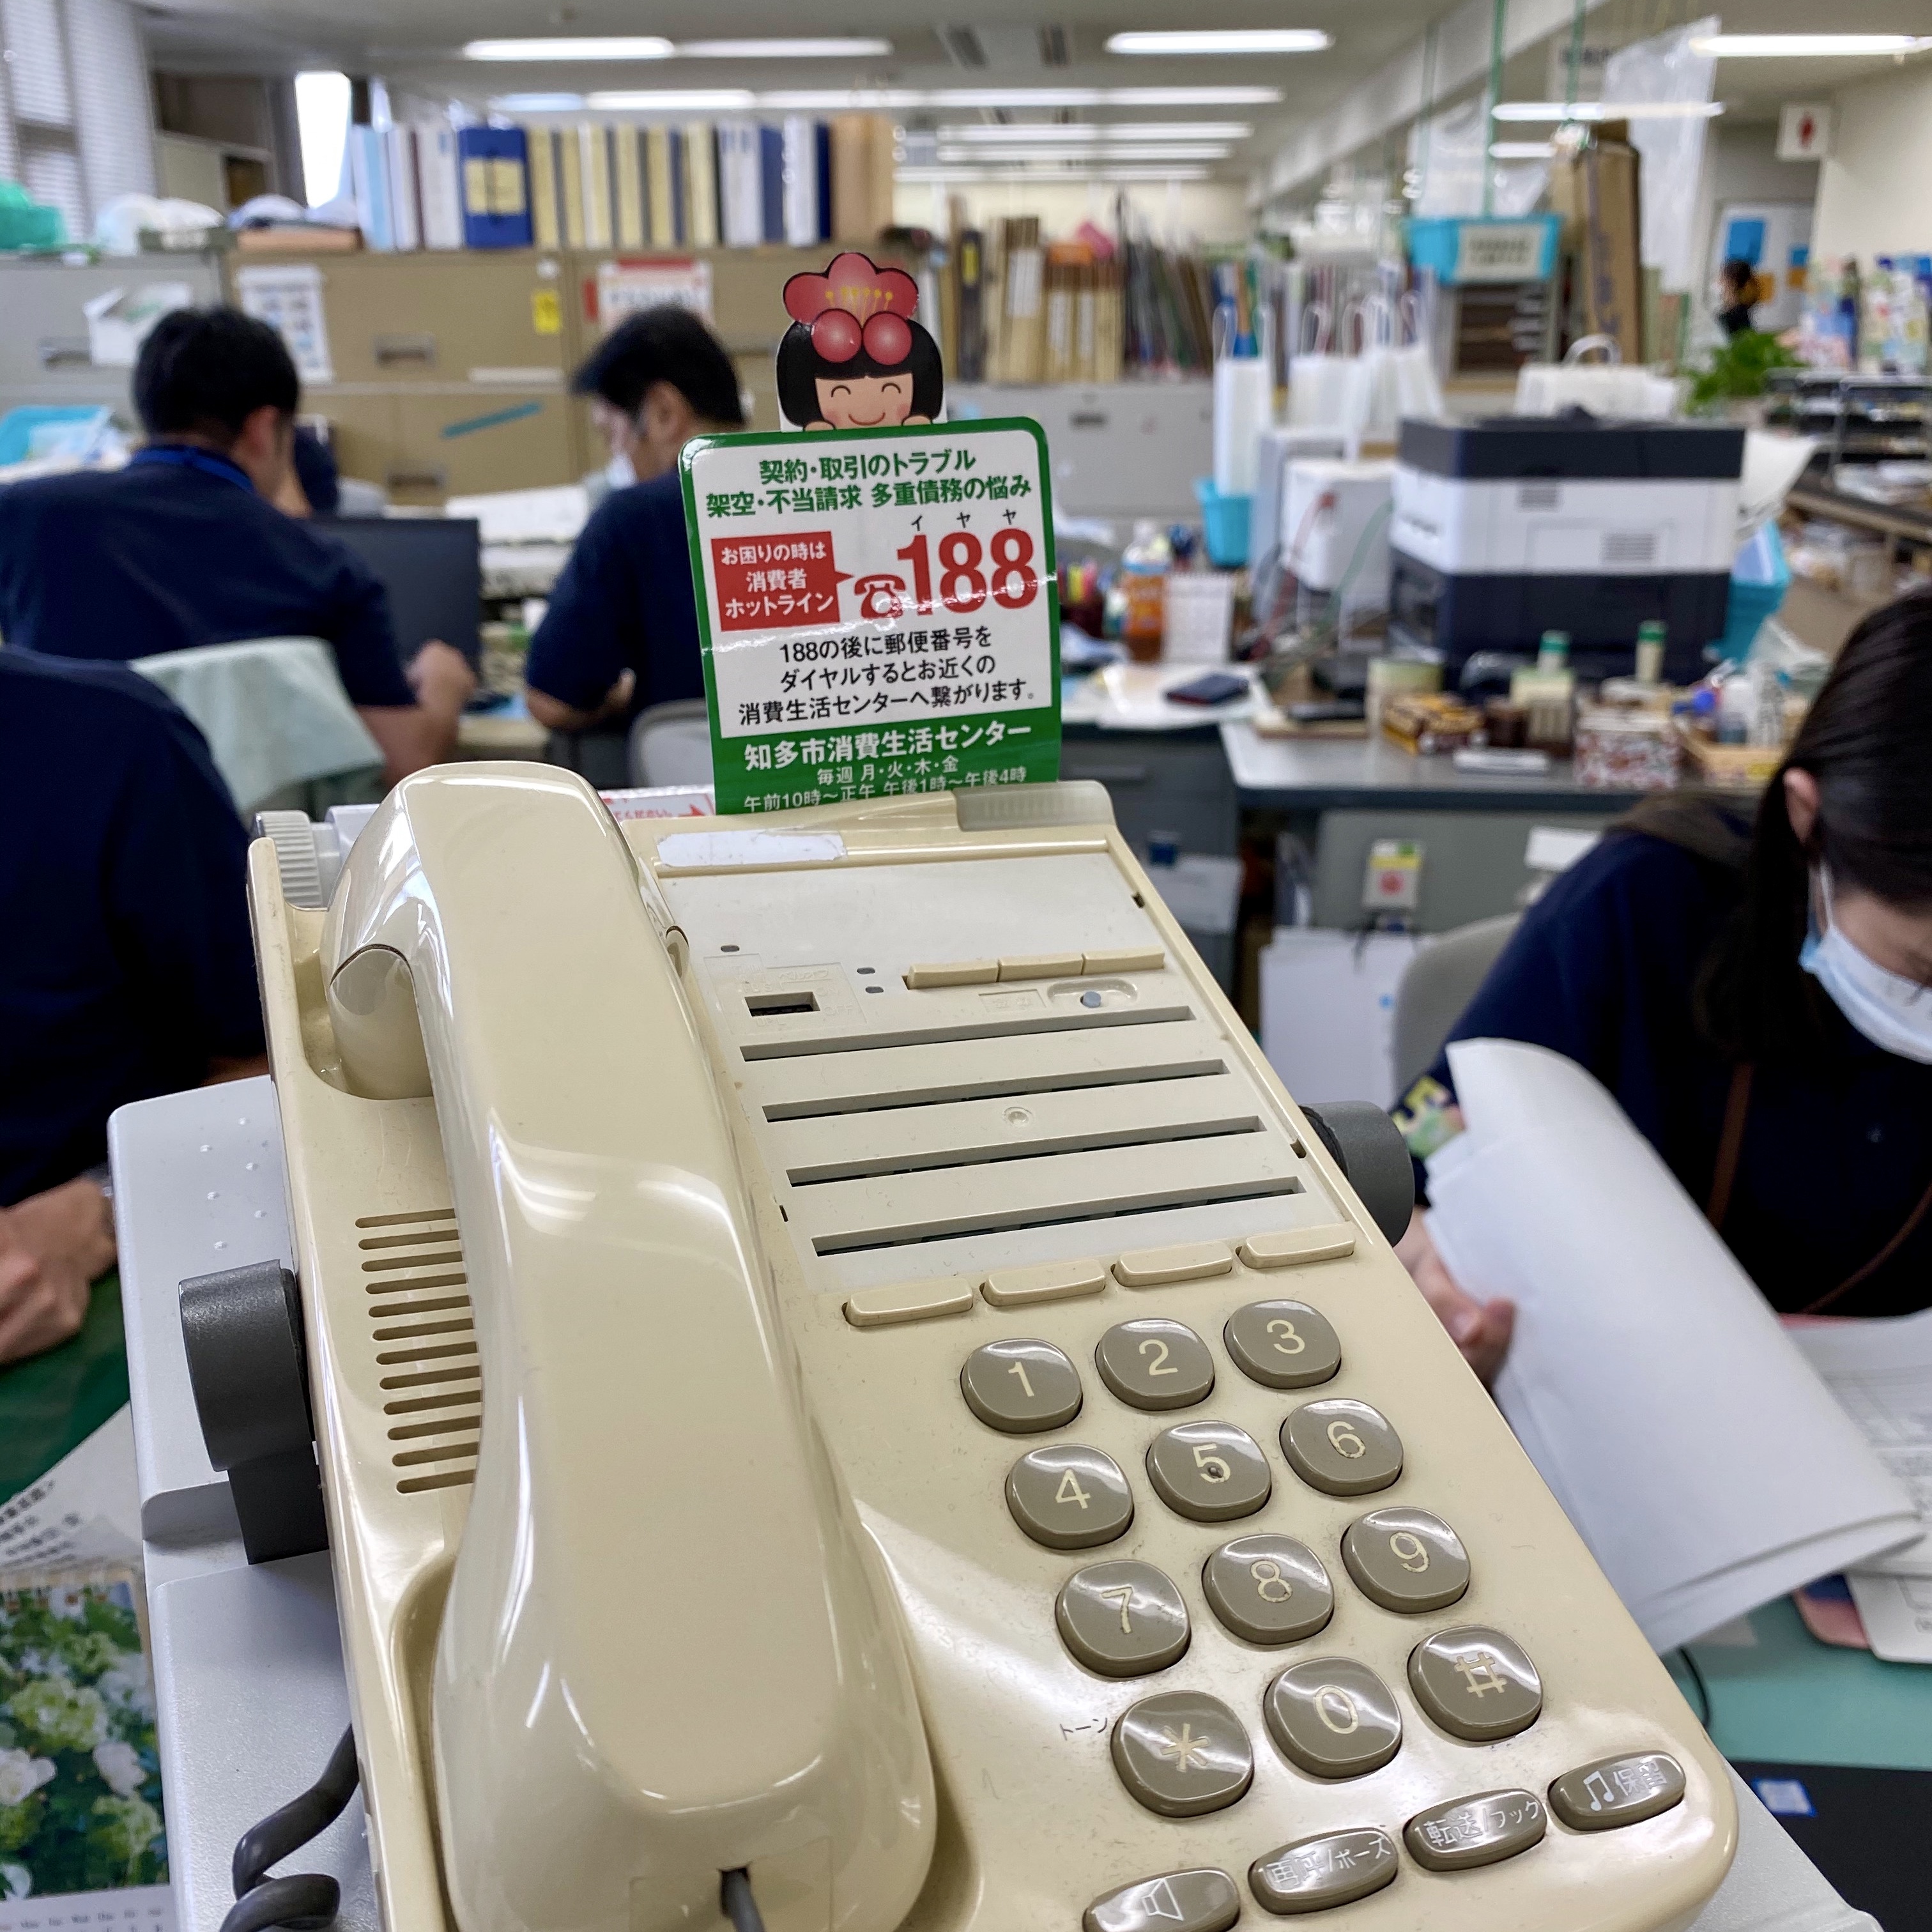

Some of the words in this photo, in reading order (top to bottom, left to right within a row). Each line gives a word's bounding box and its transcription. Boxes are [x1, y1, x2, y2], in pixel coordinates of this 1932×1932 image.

[759, 449, 976, 485] 契約・取引のトラブル
[706, 485, 862, 518] 架空・不当請求
[871, 475, 1032, 507] 多重債務の悩み
[721, 542, 827, 565] お困りの時は
[897, 528, 1038, 615] 188
[746, 568, 807, 593] 消費者
[725, 592, 834, 618] ホットライン
[779, 626, 992, 663] 188の後に郵便番号を
[780, 655, 996, 693] ダイヤルするとお近くの
[739, 678, 1034, 726] 消費生活センターへ繋がります。
[744, 719, 1032, 771] 知多市消費生活センター
[1266, 1319, 1305, 1354] 3
[1138, 1339, 1178, 1376] 2
[1008, 1361, 1034, 1397] 1
[1326, 1420, 1366, 1459] 6
[1191, 1443, 1232, 1483] 5
[1055, 1469, 1091, 1509] 4
[1390, 1532, 1429, 1573] 9
[1249, 1559, 1293, 1603] 8
[1101, 1586, 1133, 1634] 7
[1060, 1717, 1108, 1741] トーン
[1314, 1684, 1360, 1735] 0
